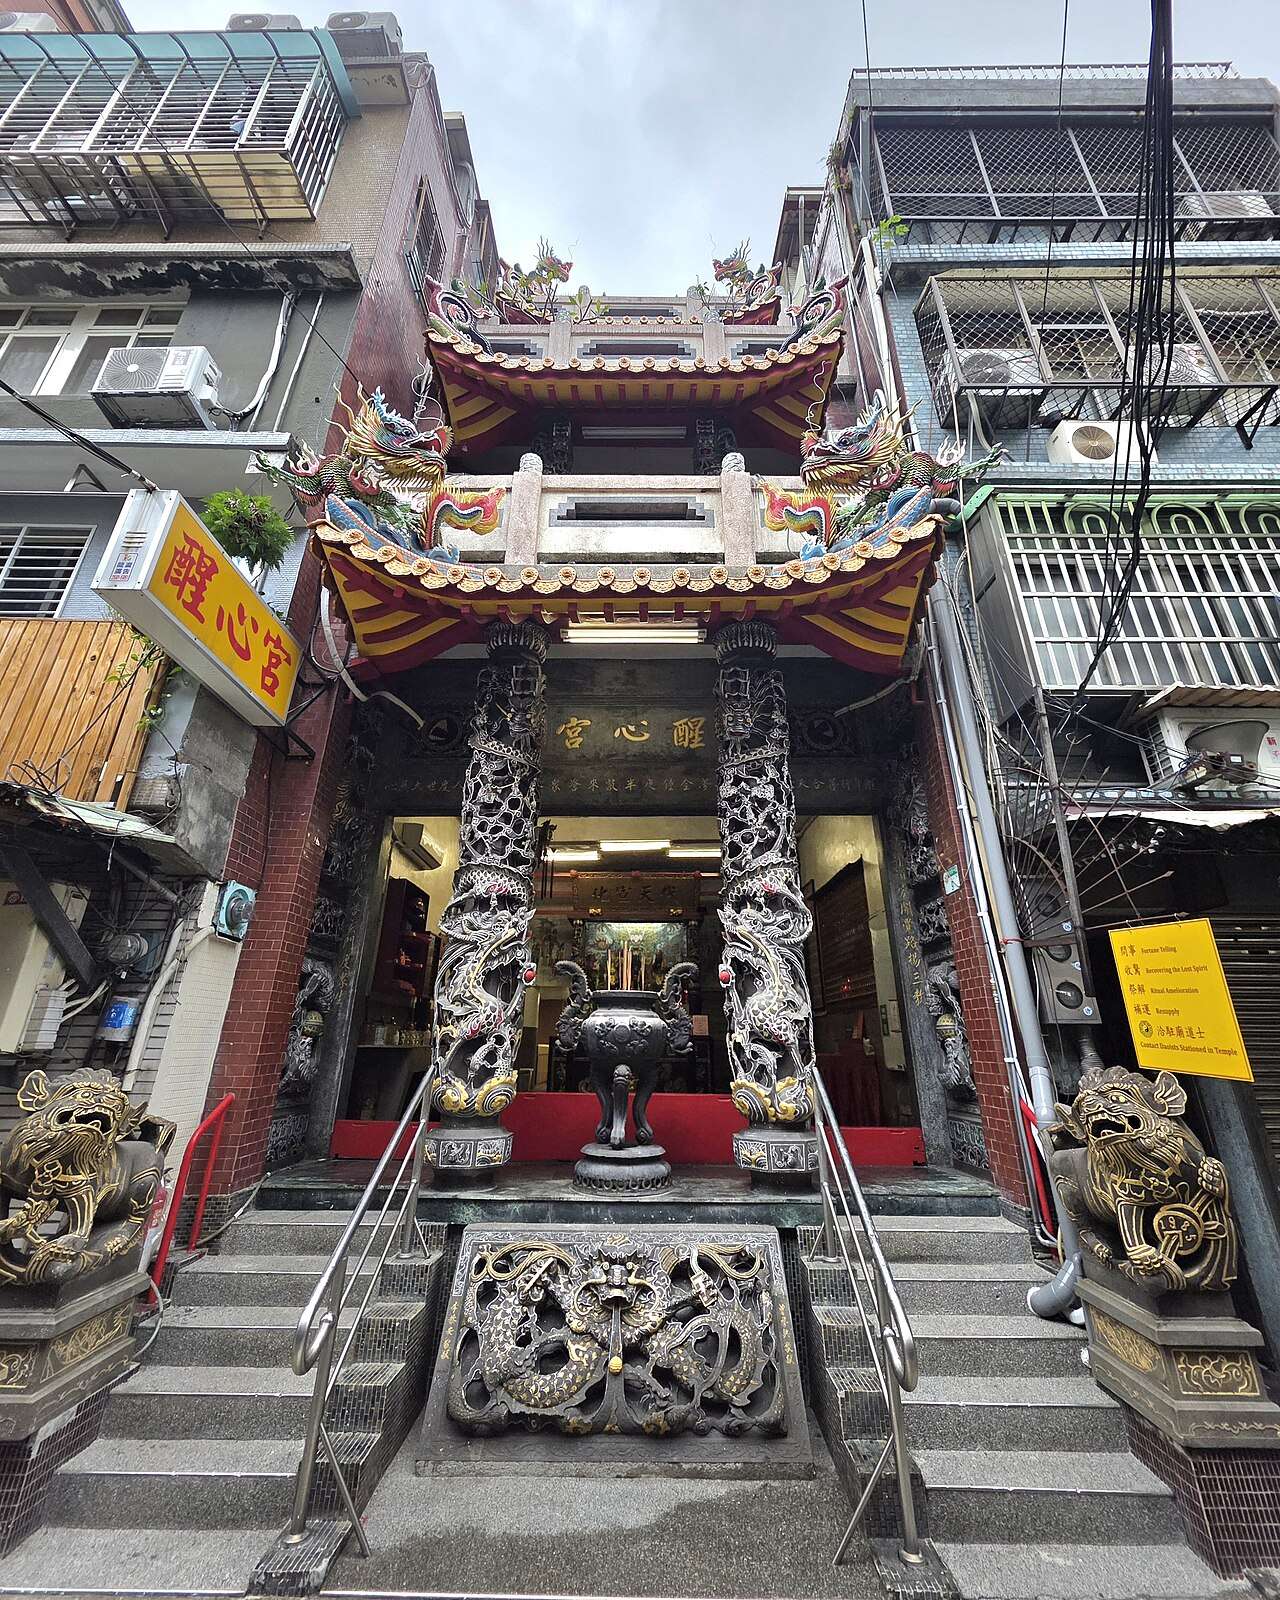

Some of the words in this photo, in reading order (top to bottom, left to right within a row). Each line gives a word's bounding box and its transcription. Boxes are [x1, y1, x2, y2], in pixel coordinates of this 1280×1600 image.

[164, 530, 292, 698] 醒心宮
[555, 716, 705, 750] 醒心宮
[1120, 944, 1136, 957] 問事
[1125, 964, 1141, 976] 收驚
[1193, 965, 1208, 973] Spirit
[1134, 1003, 1151, 1015] 補運
[1156, 1007, 1180, 1016] Resupply
[1180, 1044, 1207, 1053] Stationed
[1207, 1046, 1214, 1054] in
[1214, 1047, 1238, 1056] Temple
[1159, 1216, 1197, 1242] 1985
